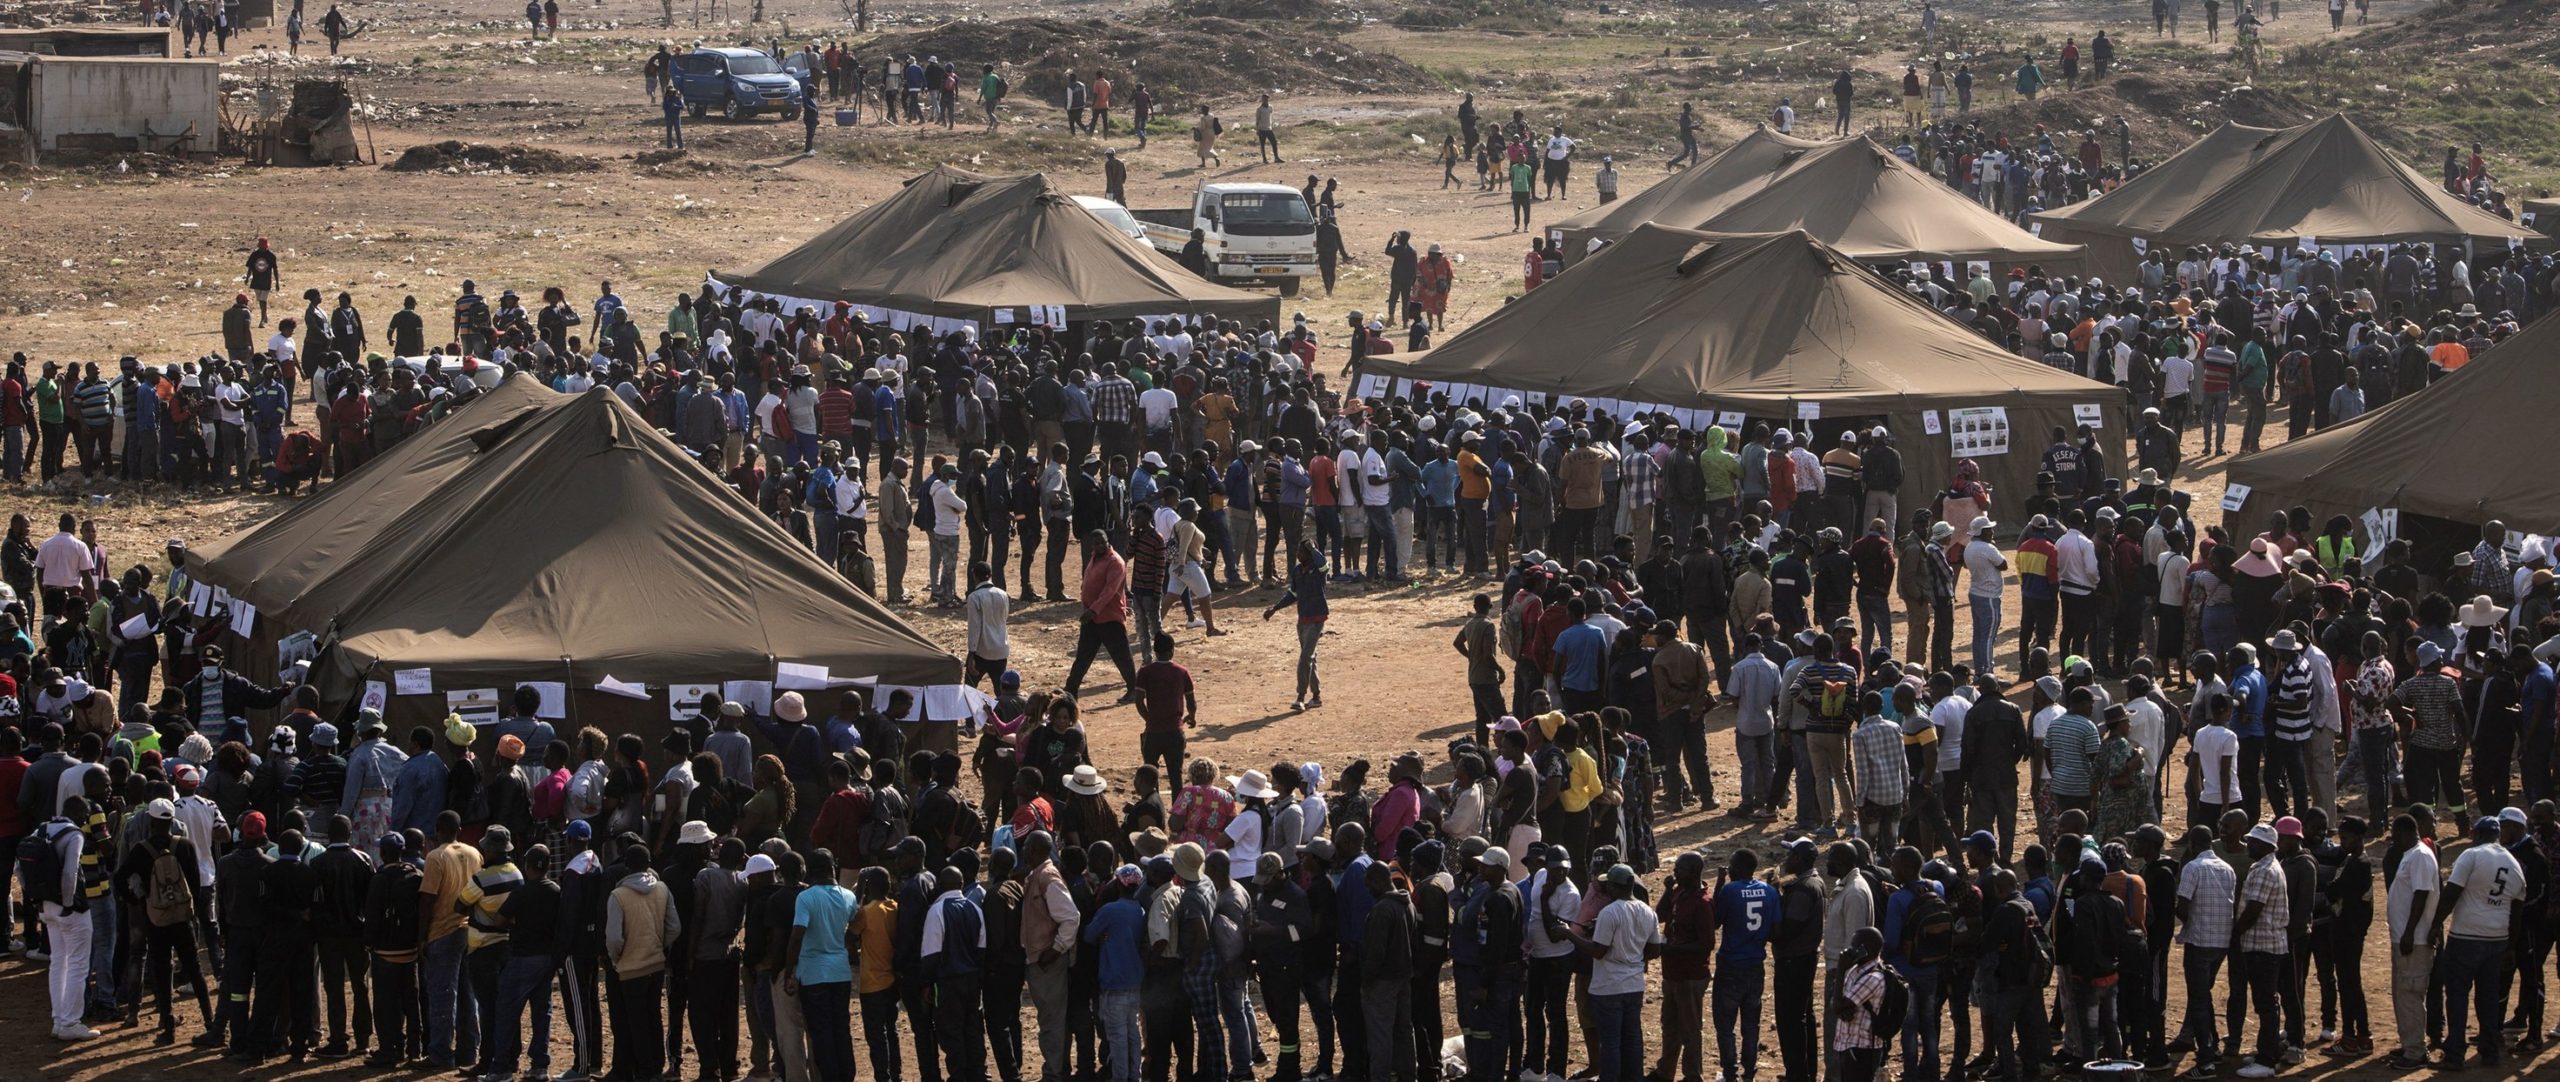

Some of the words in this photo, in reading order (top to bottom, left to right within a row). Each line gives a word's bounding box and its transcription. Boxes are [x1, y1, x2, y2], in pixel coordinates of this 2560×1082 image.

[2052, 450, 2079, 462] DESERT
[2055, 463, 2076, 472] STORM
[1741, 888, 1766, 898] FELKER
[1746, 901, 1763, 931] 5
